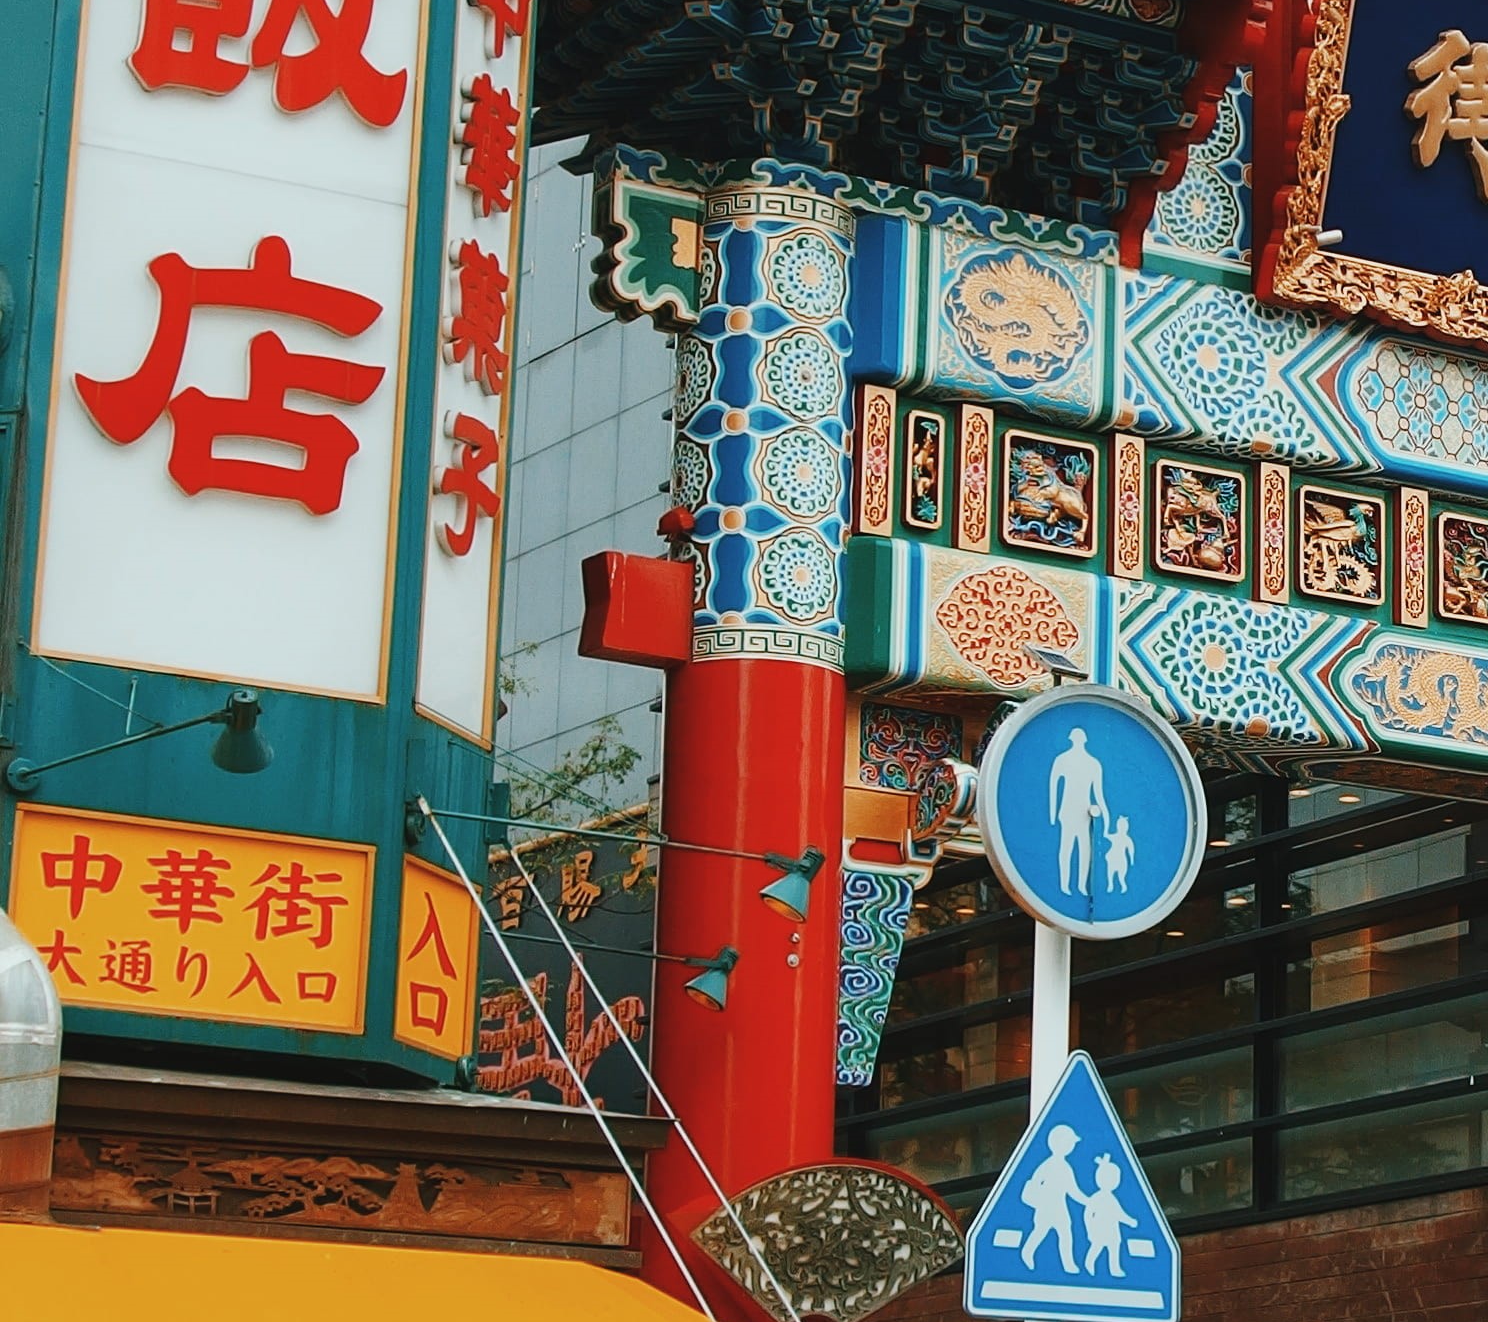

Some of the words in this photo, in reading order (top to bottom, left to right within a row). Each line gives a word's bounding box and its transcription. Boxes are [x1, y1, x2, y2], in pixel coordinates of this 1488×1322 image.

[40, 834, 349, 949] 中華街
[44, 927, 339, 1006] 大通り入口
[406, 890, 458, 1037] 入口
